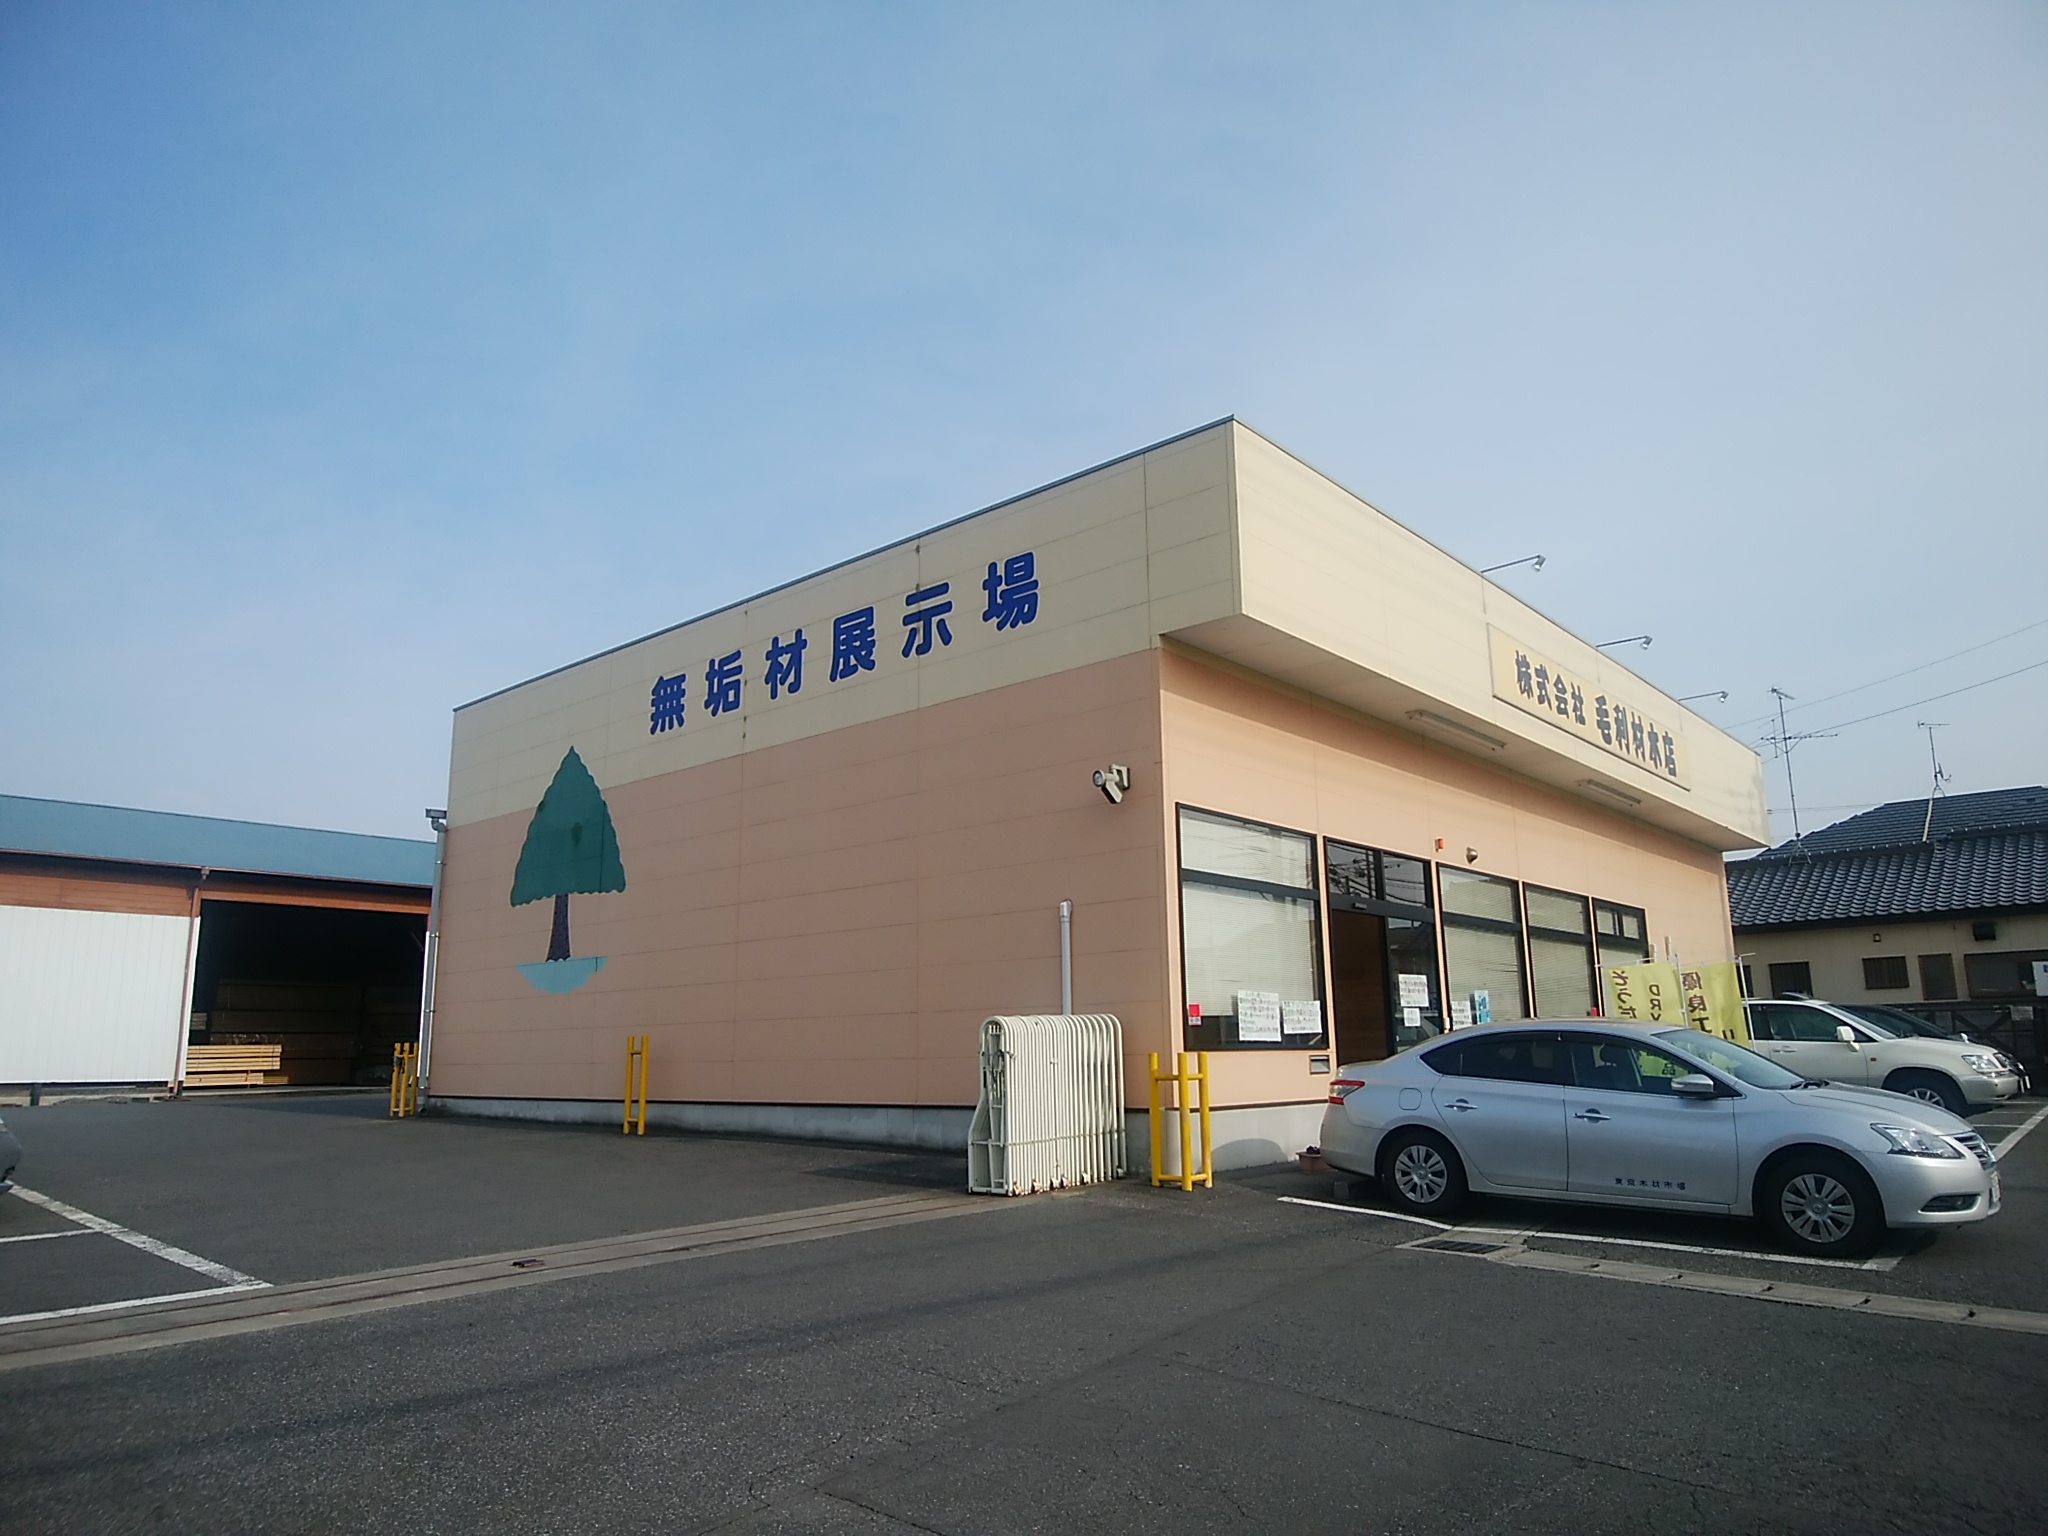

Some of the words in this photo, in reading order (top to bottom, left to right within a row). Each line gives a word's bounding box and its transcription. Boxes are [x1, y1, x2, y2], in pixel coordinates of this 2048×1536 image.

[650, 551, 1039, 735] 無垢材展示場
[1514, 649, 1586, 725] 株式会社
